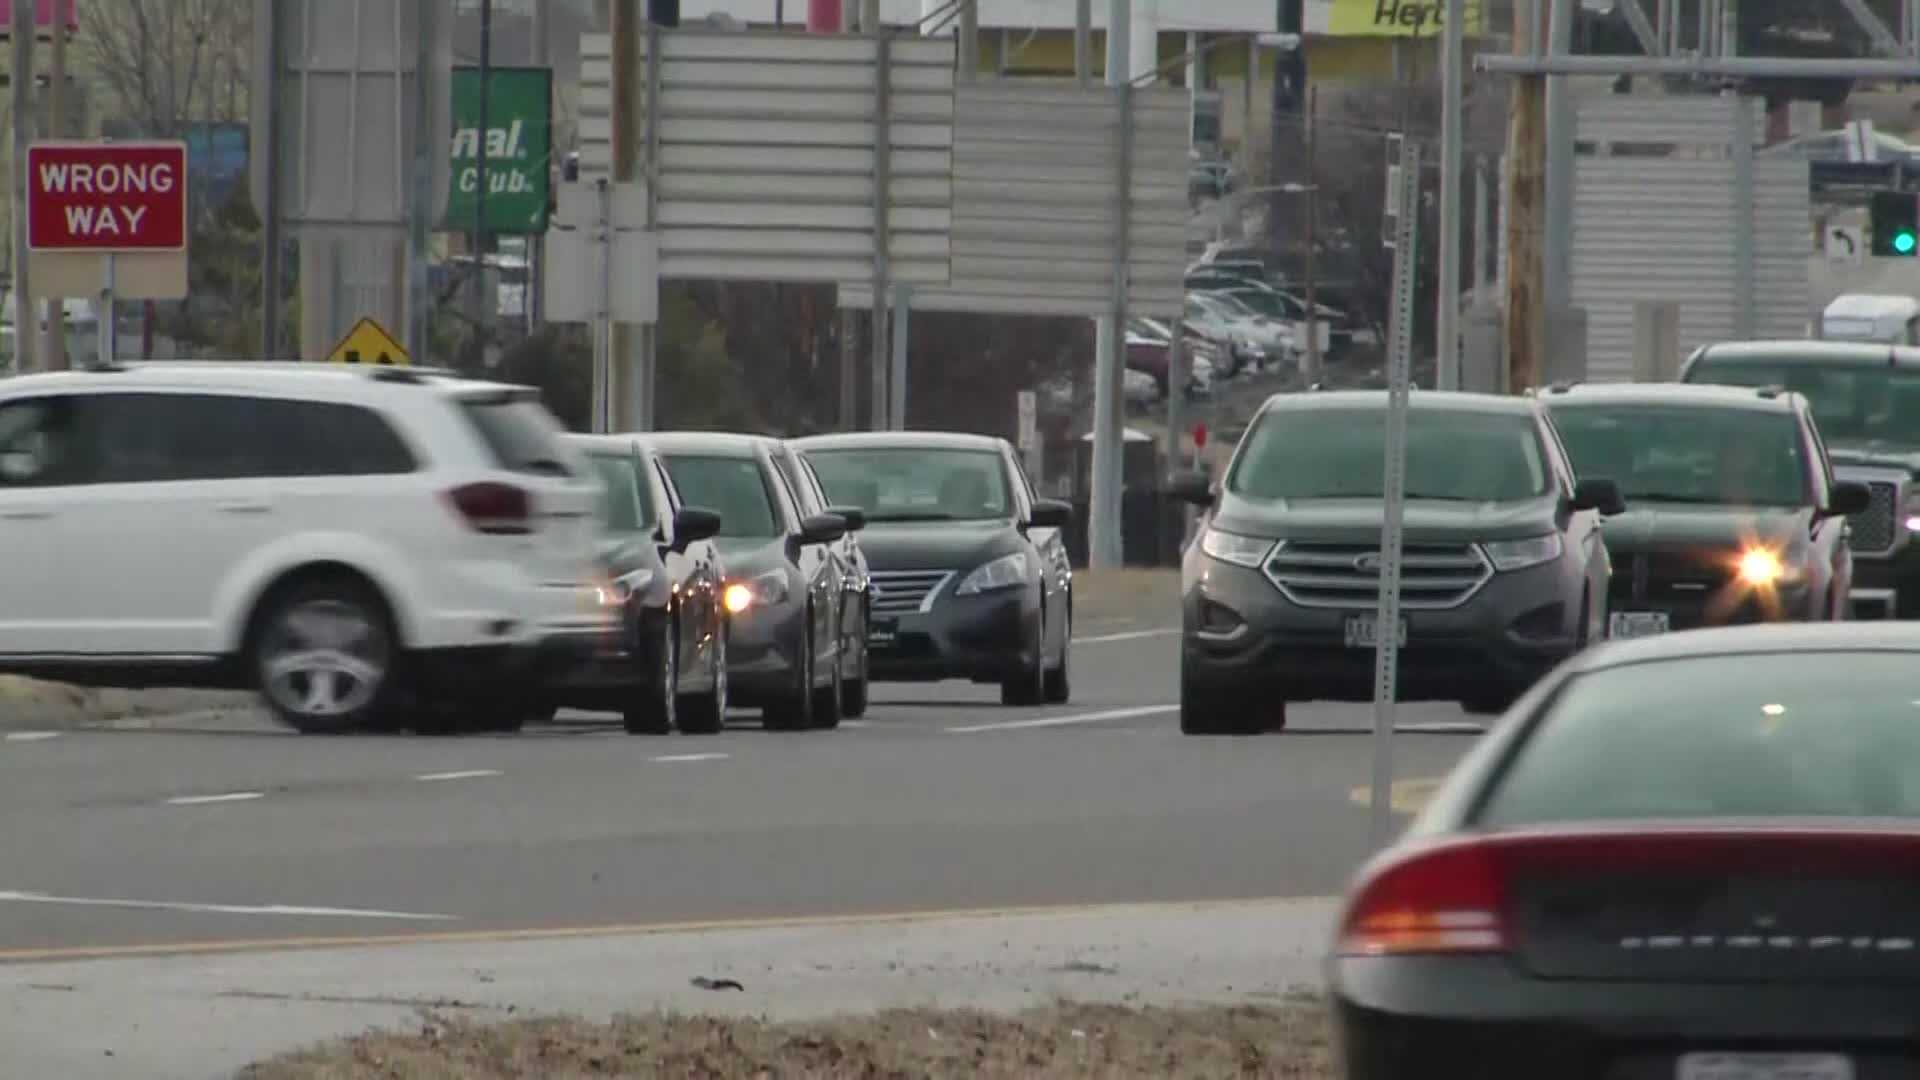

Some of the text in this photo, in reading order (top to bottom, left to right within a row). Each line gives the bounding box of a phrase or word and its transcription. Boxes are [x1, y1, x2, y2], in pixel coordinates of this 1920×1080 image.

[1374, 0, 1477, 26] Hert
[39, 162, 174, 193] WRONG
[64, 205, 148, 235] WAY
